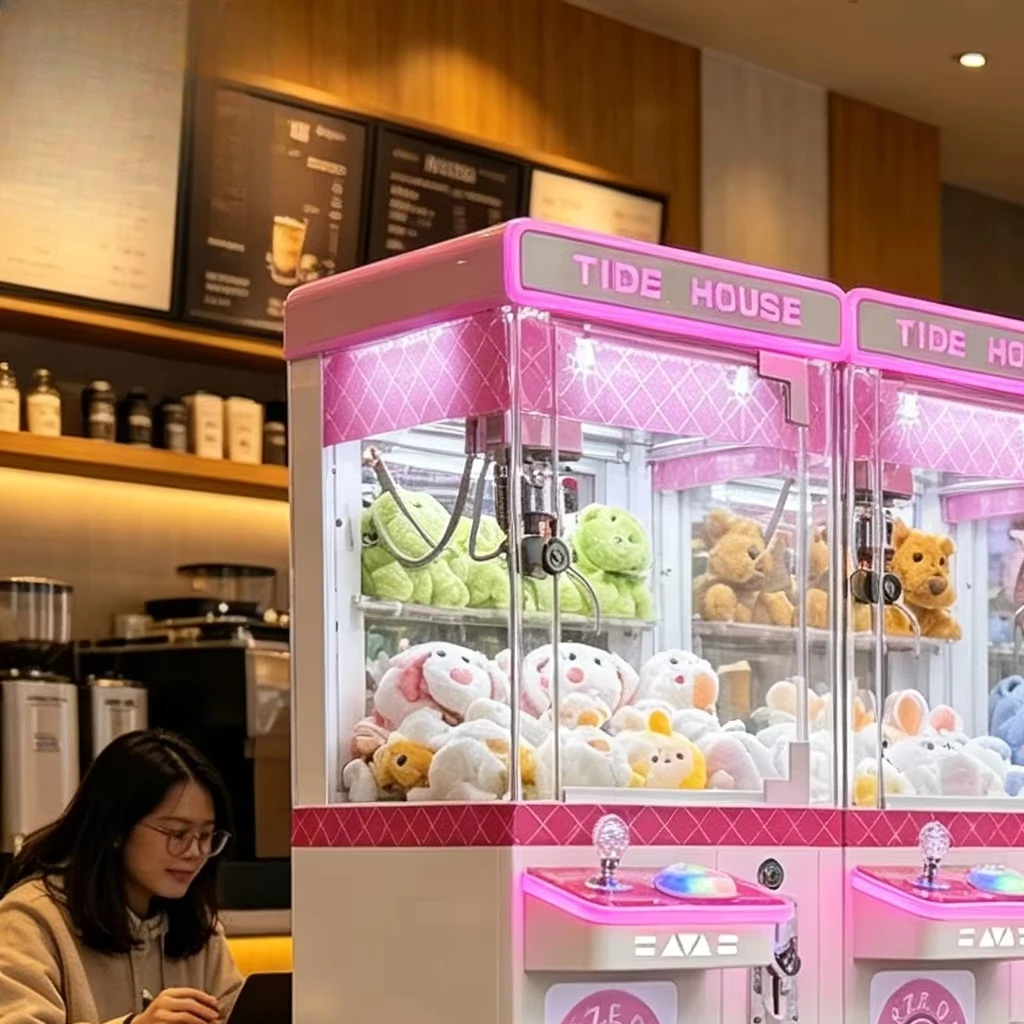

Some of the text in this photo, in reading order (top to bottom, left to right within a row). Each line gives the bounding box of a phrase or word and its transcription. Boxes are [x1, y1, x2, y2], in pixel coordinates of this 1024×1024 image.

[573, 254, 802, 326] TIDE HOUSE
[896, 319, 966, 358] TIDE
